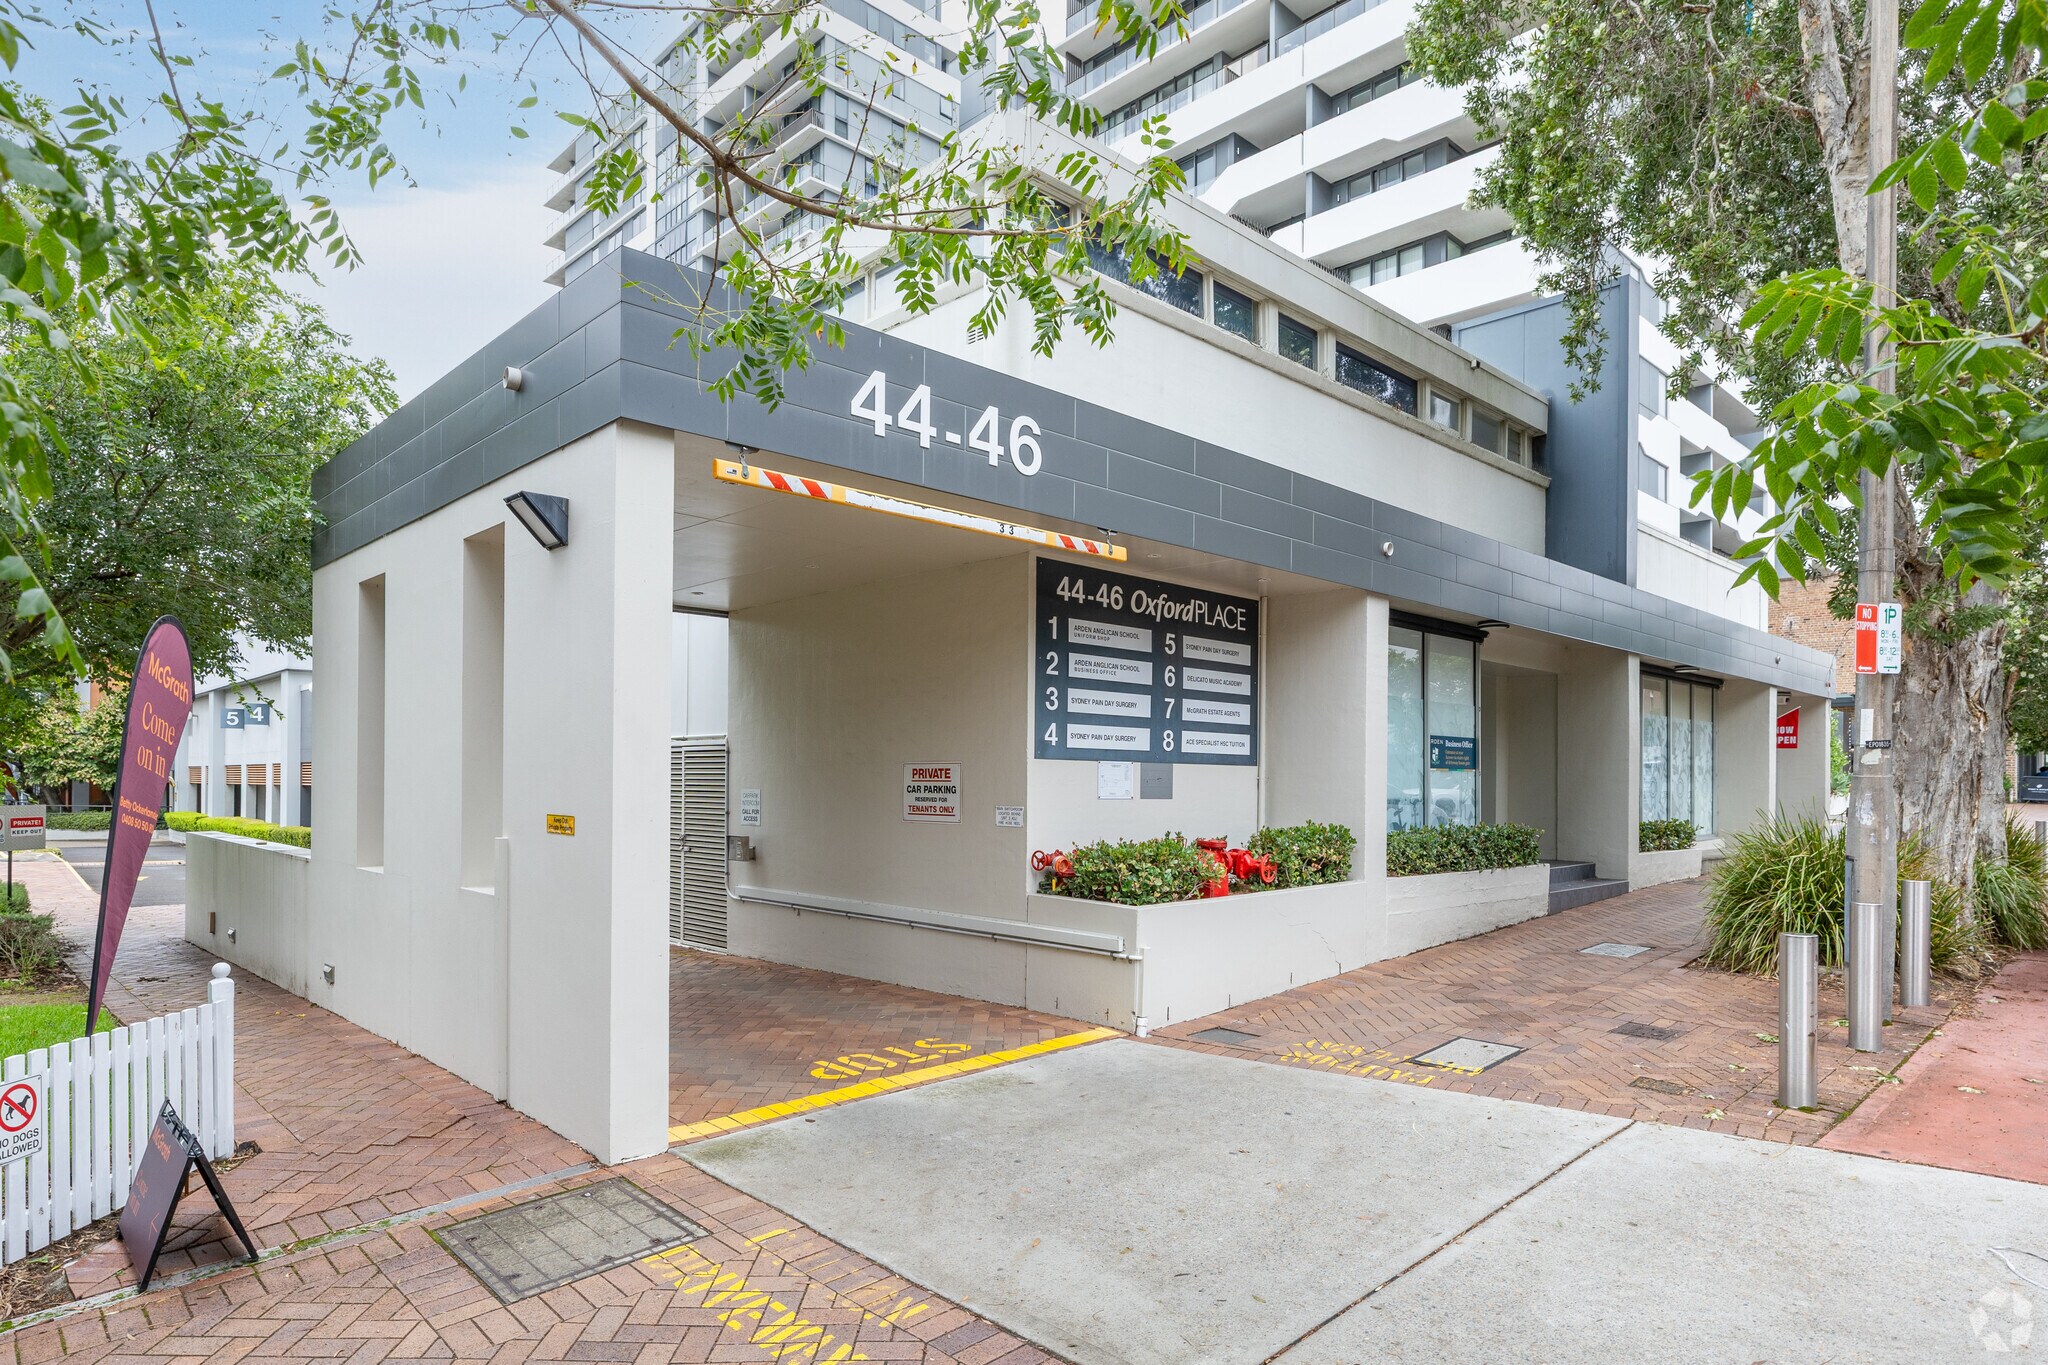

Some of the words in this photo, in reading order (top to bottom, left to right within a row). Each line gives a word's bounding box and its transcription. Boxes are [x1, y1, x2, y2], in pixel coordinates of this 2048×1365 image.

[850, 370, 1043, 477] 44-46
[1000, 523, 1005, 533] 3
[1009, 526, 1014, 535] 3
[1056, 576, 1124, 611] 44-46
[1862, 608, 1872, 619] NO
[1884, 608, 1897, 624] 1P
[1049, 616, 1057, 640] 1
[1074, 625, 1092, 633] ARDEN
[1093, 627, 1119, 637] ANGLICAN
[1119, 631, 1140, 640] SCHOOL
[1857, 621, 1877, 631] STOPPING
[1074, 632, 1096, 640] UNIFORM
[1164, 633, 1176, 655] 5
[1186, 643, 1202, 651] SYDNEY
[1222, 649, 1240, 657] SURGERY
[1045, 651, 1059, 676] 2
[1074, 666, 1098, 674] BUSINESS
[1093, 662, 1119, 670] ANGLICAN
[1120, 664, 1140, 672] SCHOOL
[148, 651, 189, 705] McGrath
[1164, 665, 1176, 687] 6
[1187, 675, 1208, 684] DELICATO
[1045, 686, 1059, 711] 3
[1071, 697, 1091, 705] SYDNEY
[1115, 701, 1138, 709] SURGERY
[250, 706, 264, 722] 4
[1164, 698, 1175, 719] 7
[1186, 707, 1208, 715] McGRATH
[1224, 710, 1241, 718] AGENTS
[142, 702, 175, 746] Come
[226, 711, 239, 726] 5
[1044, 722, 1058, 746] 4
[1163, 730, 1174, 752] 8
[1777, 735, 1797, 744] PEN
[1445, 739, 1461, 748] Business
[1461, 741, 1473, 749] Office
[137, 745, 153, 771] on
[155, 746, 166, 778] in
[912, 768, 951, 779] PRIVATE
[906, 785, 921, 793] CAR
[923, 785, 956, 794] PARKING
[908, 805, 937, 813] TENANTS
[939, 805, 955, 813] ONLY
[134, 818, 142, 829] 50
[141, 820, 149, 832] 50
[810, 1037, 972, 1080] STOP
[13, 1127, 39, 1144] DOGS
